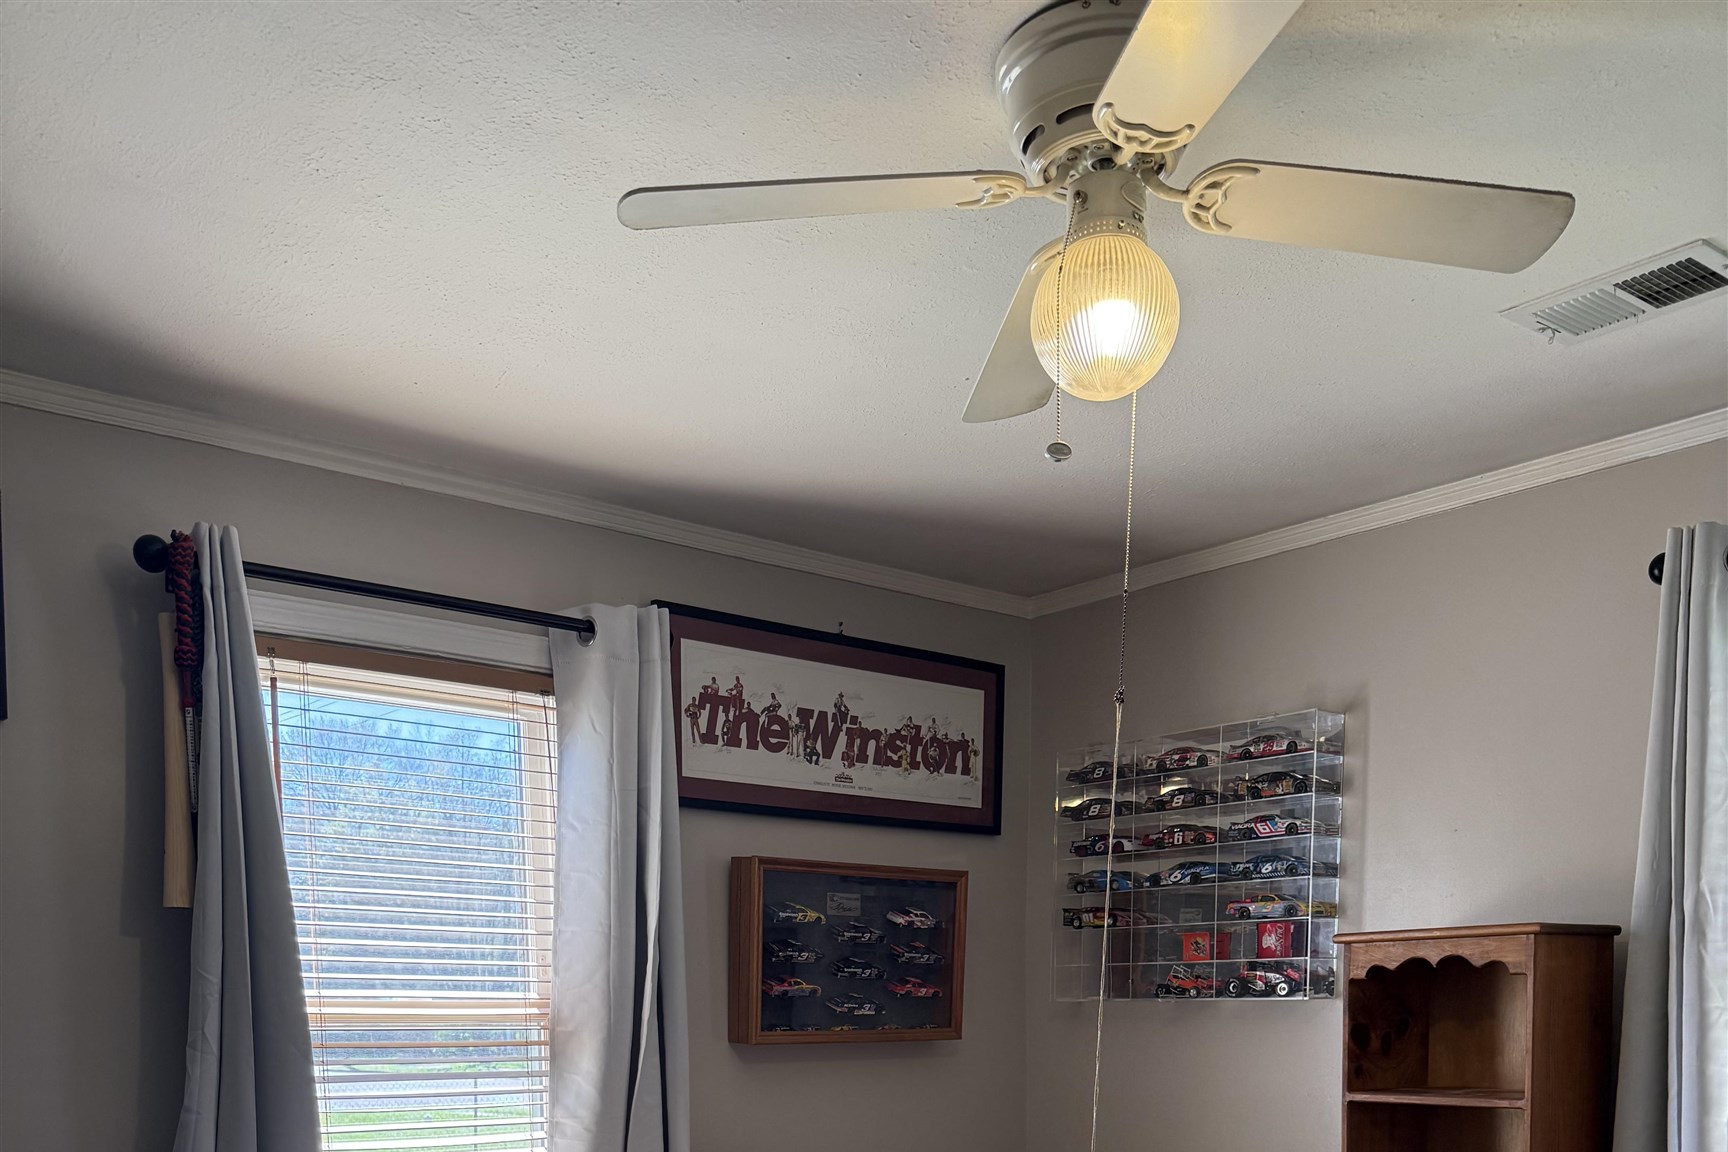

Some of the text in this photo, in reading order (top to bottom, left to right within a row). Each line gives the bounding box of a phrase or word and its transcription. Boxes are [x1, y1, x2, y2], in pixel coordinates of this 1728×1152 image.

[698, 691, 972, 777] The Winston
[1262, 740, 1275, 752] 29
[1093, 767, 1105, 778] 8
[1172, 795, 1185, 807] 8
[1088, 804, 1101, 816] 8
[1174, 832, 1183, 845] 6
[1094, 841, 1105, 852] 6
[1261, 863, 1273, 873] 6
[1170, 869, 1182, 882] 6
[861, 933, 871, 941] 3
[798, 952, 809, 960] 3
[862, 969, 871, 977] 3
